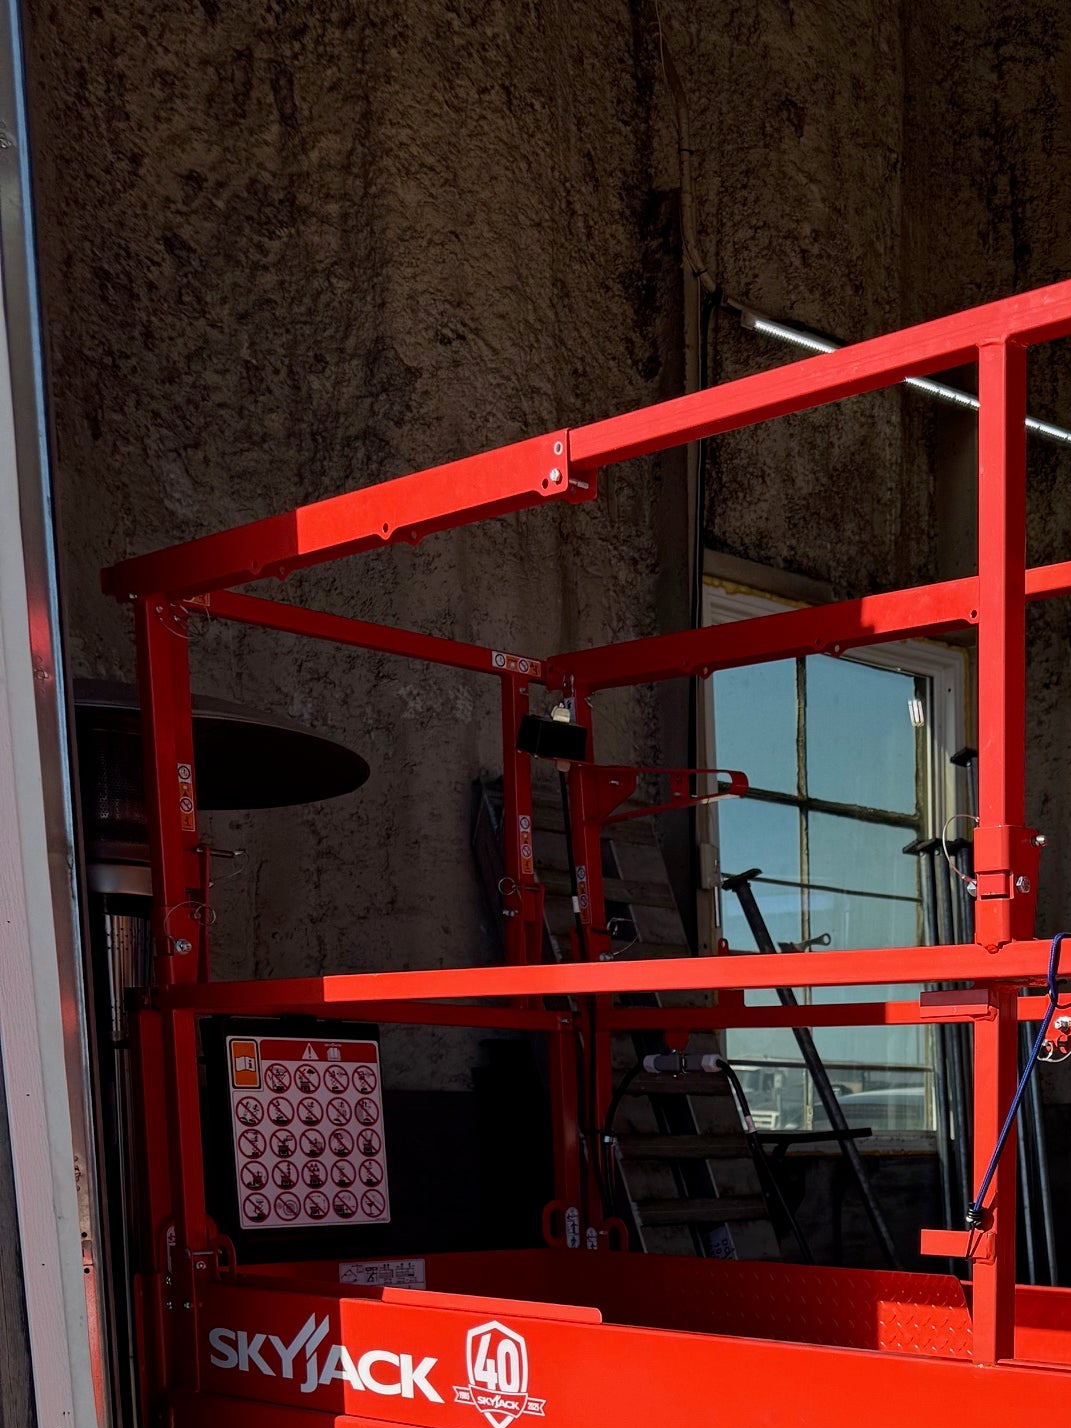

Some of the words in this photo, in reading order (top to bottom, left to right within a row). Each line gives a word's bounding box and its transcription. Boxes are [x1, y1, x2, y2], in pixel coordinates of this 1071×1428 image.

[208, 1312, 445, 1404] SKYJACK
[474, 1333, 520, 1393] 40
[477, 1395, 520, 1411] SKYJACK
